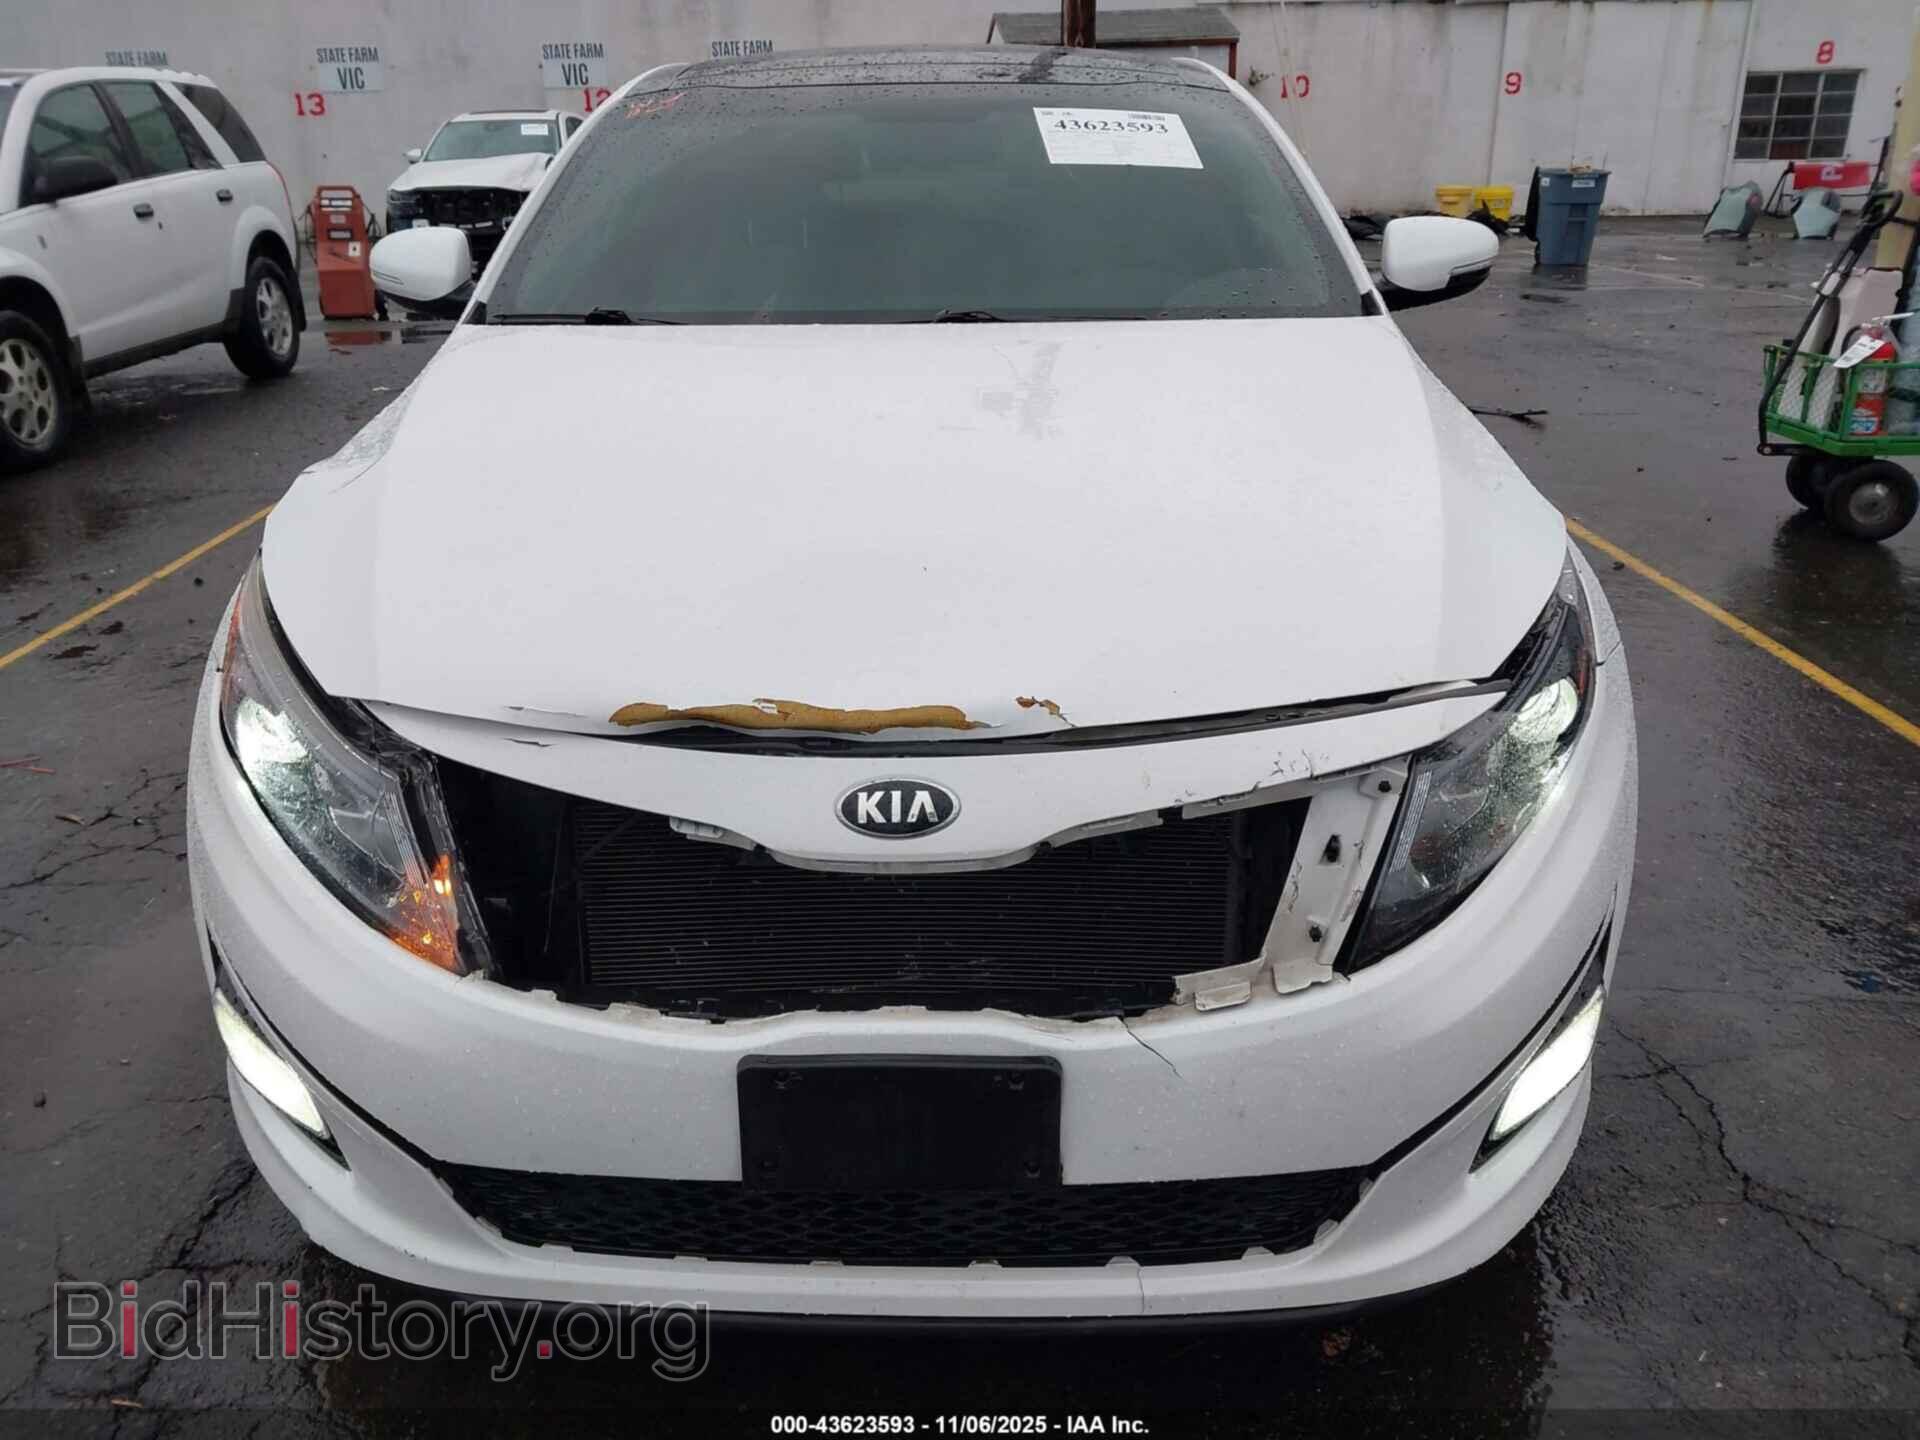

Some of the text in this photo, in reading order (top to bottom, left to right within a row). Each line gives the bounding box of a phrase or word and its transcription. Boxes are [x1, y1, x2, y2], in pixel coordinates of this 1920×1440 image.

[316, 47, 379, 63] STATE FARM
[542, 43, 604, 60] STATE FARM
[711, 39, 774, 57] STATE FARM
[1816, 40, 1835, 64] 8
[337, 67, 365, 90] VIC
[561, 63, 589, 86] VIC
[1504, 71, 1522, 95] 9
[294, 92, 326, 117] 13
[1054, 119, 1168, 134] 43623593
[857, 790, 939, 823] KIA
